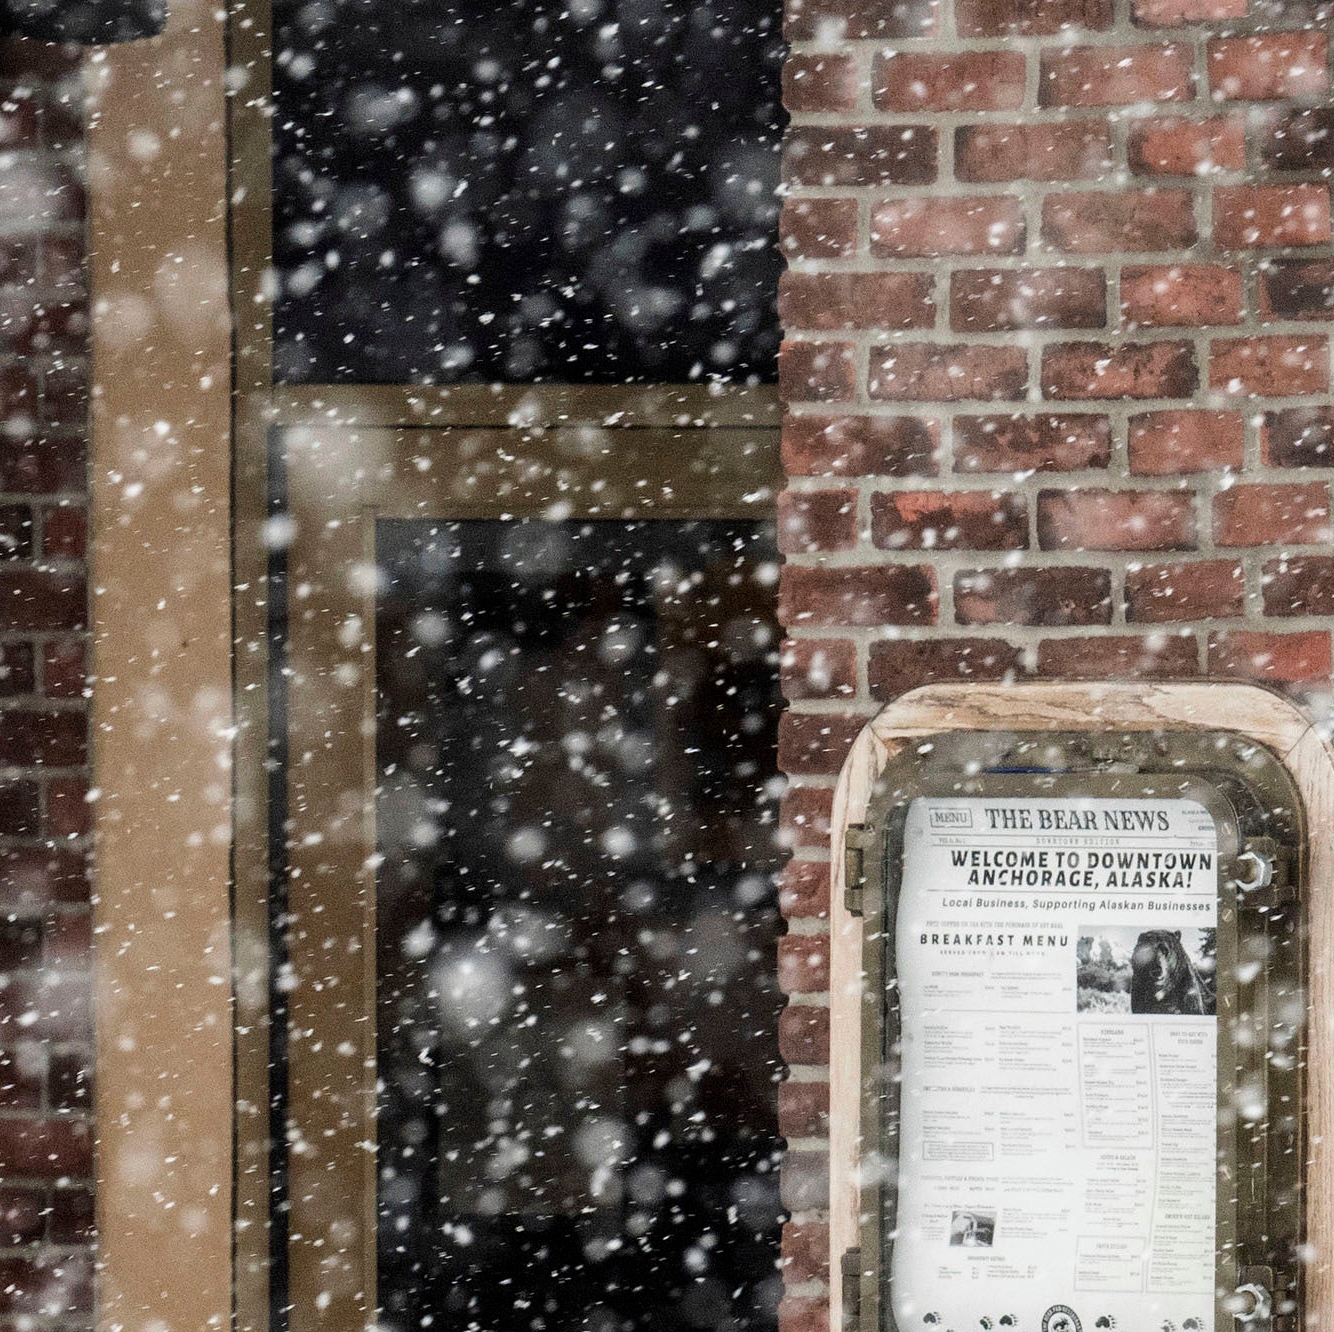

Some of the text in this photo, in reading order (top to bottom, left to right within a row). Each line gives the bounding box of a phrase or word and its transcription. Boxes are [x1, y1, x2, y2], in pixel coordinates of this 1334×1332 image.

[935, 811, 968, 824] MENU
[984, 808, 1170, 832] THE BEAR NEWS
[951, 850, 1212, 870] WELCOME TO DOWNTOWN
[967, 869, 1193, 890] ANCHORAGE, ALASKA!
[942, 898, 1211, 911] Local Business, Supporting Alaskan Businesses
[920, 933, 1068, 947] BREAKFAST MENU
